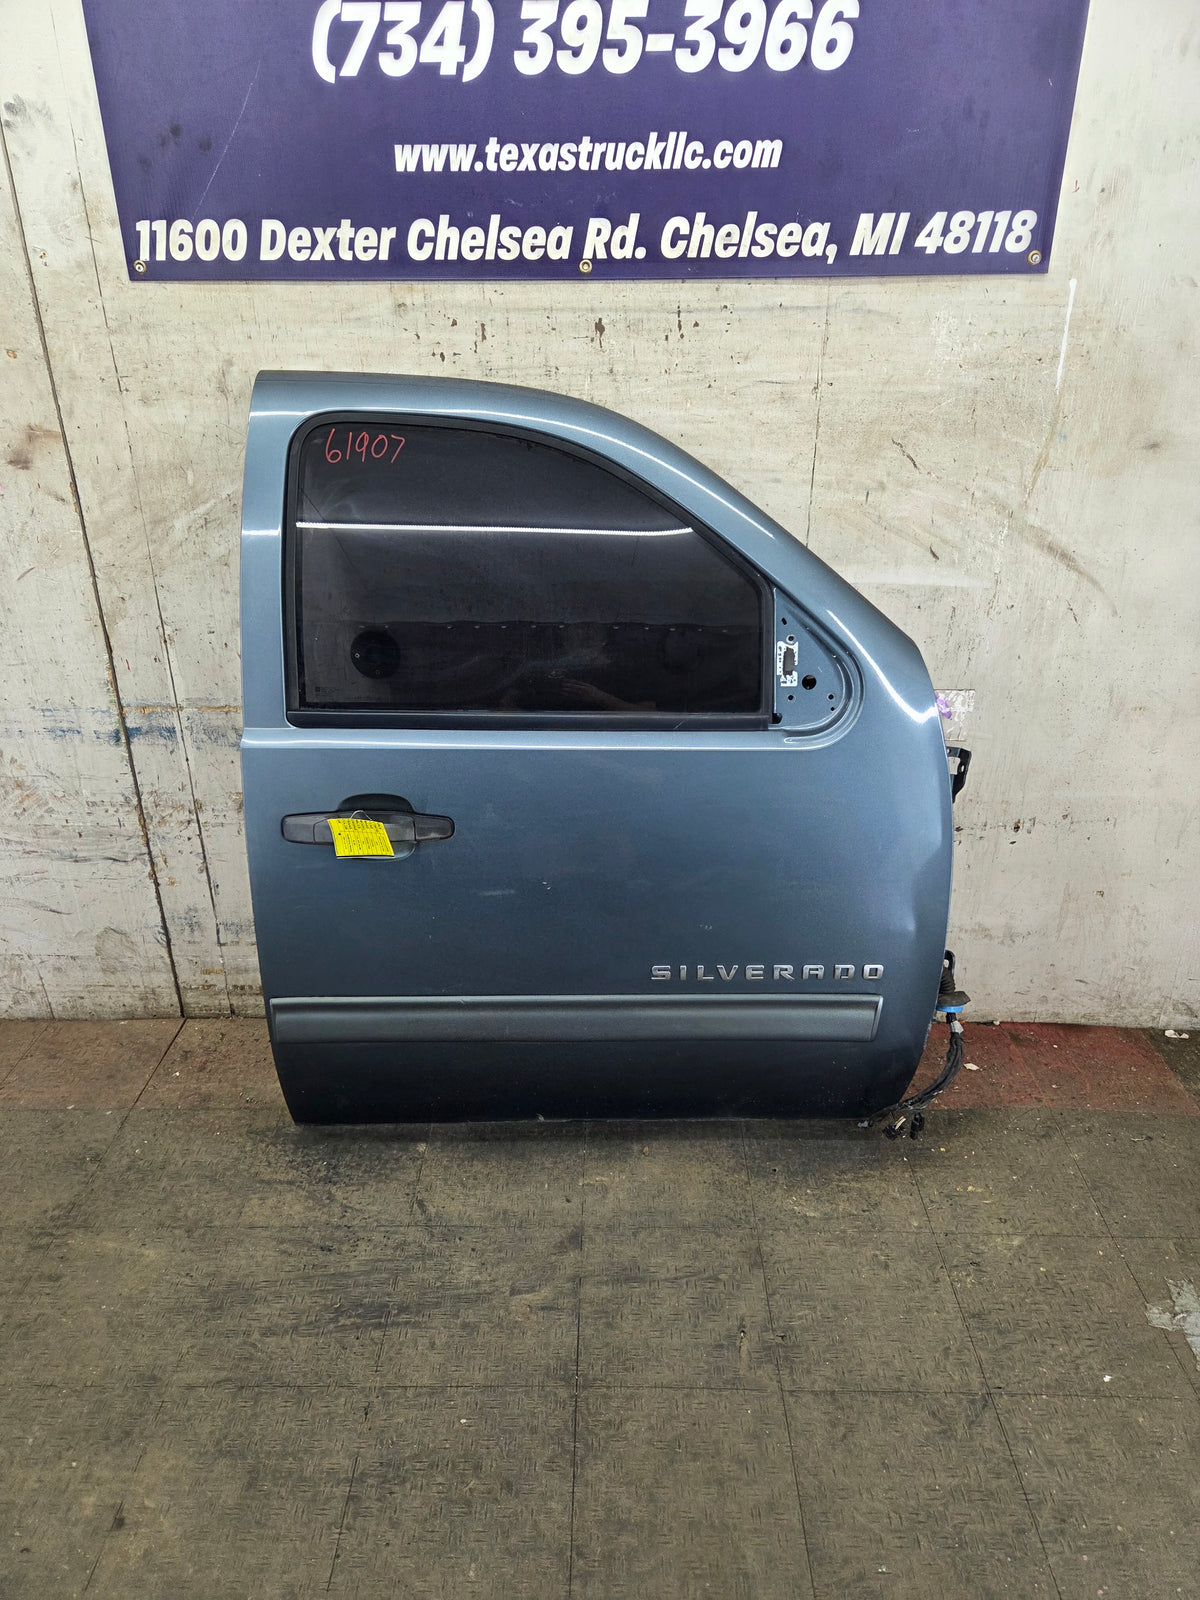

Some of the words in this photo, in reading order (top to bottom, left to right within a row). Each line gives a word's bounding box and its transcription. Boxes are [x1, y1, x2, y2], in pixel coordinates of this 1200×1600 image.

[311, 0, 495, 84] (734)
[513, 0, 860, 75] 395-3966
[394, 131, 783, 173] www.texastruckllc.com
[135, 218, 248, 262] 11600
[259, 219, 397, 261] Dexter
[406, 214, 573, 262] Chelsea
[585, 213, 648, 261] Rd.
[660, 211, 838, 265] Chelsea,
[849, 212, 909, 257] MI
[914, 209, 1038, 255] 48118
[325, 428, 406, 464] 61907
[650, 964, 885, 981] SILVERADO
